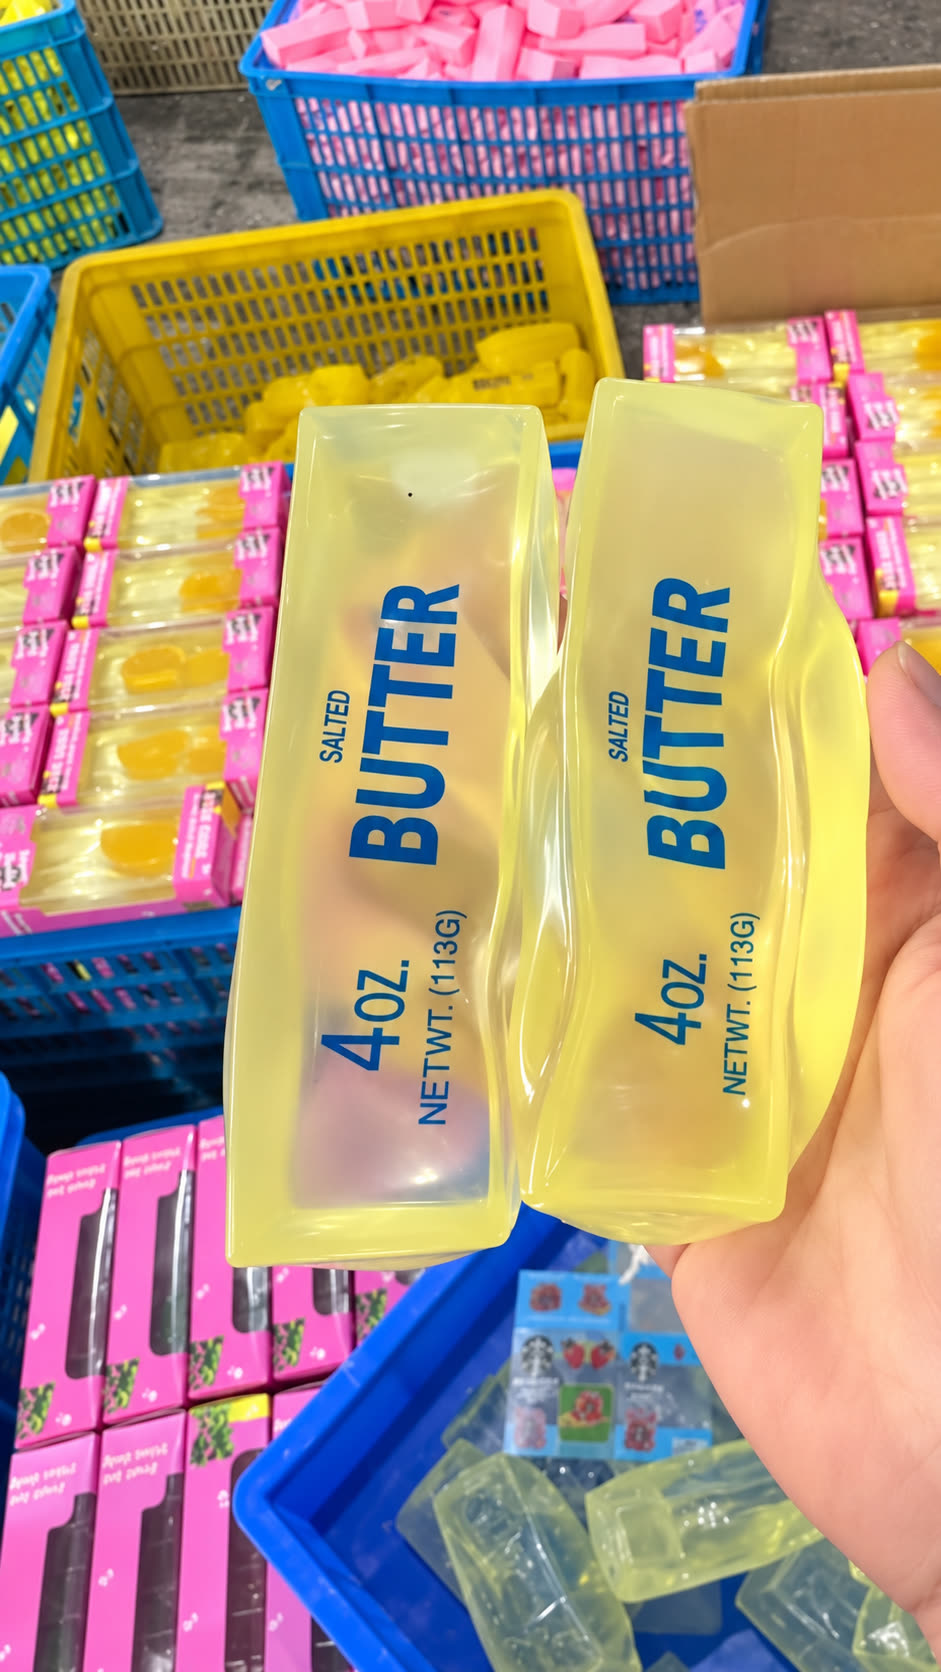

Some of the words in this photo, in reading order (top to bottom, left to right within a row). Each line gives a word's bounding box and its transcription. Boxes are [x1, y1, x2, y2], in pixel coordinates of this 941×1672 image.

[320, 690, 350, 763] SALTED
[349, 584, 460, 866] BUTTER
[608, 691, 630, 762] SALTED
[642, 578, 730, 869] BUTTER
[428, 911, 467, 995] (113G)
[728, 912, 760, 991] (113G)
